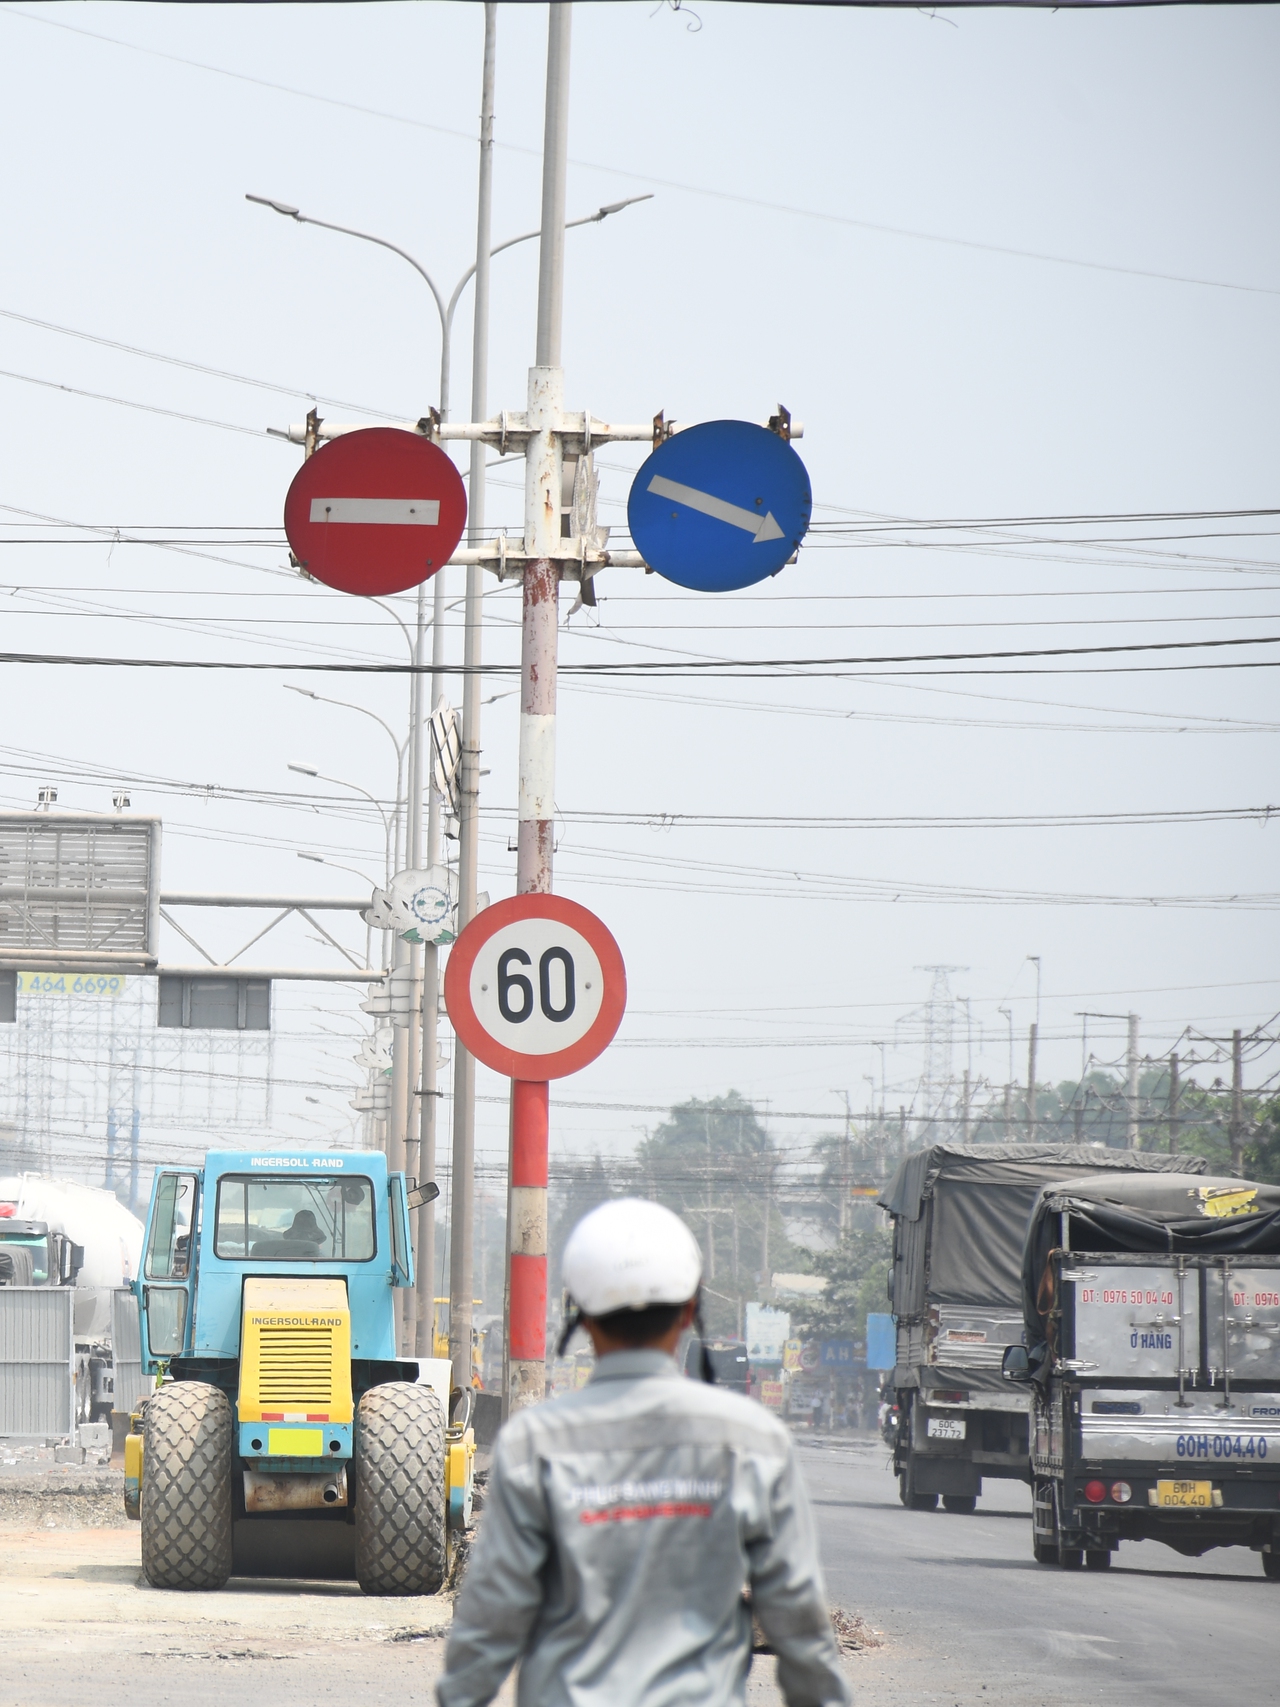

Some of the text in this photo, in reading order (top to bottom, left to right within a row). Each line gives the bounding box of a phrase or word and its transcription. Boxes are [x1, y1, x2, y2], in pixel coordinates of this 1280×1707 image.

[30, 976, 66, 993] 464
[73, 976, 120, 994] 6699
[497, 946, 576, 1024] 60
[251, 1157, 309, 1167] INGERSOLL
[1103, 1290, 1127, 1304] 0976
[1130, 1291, 1143, 1304] 50
[1146, 1291, 1158, 1305] 04
[1160, 1291, 1173, 1305] 40
[1255, 1292, 1279, 1306] 0976
[1141, 1330, 1172, 1349] HÀNG
[1173, 1482, 1196, 1494] 60H
[1163, 1494, 1206, 1506] 004.40
